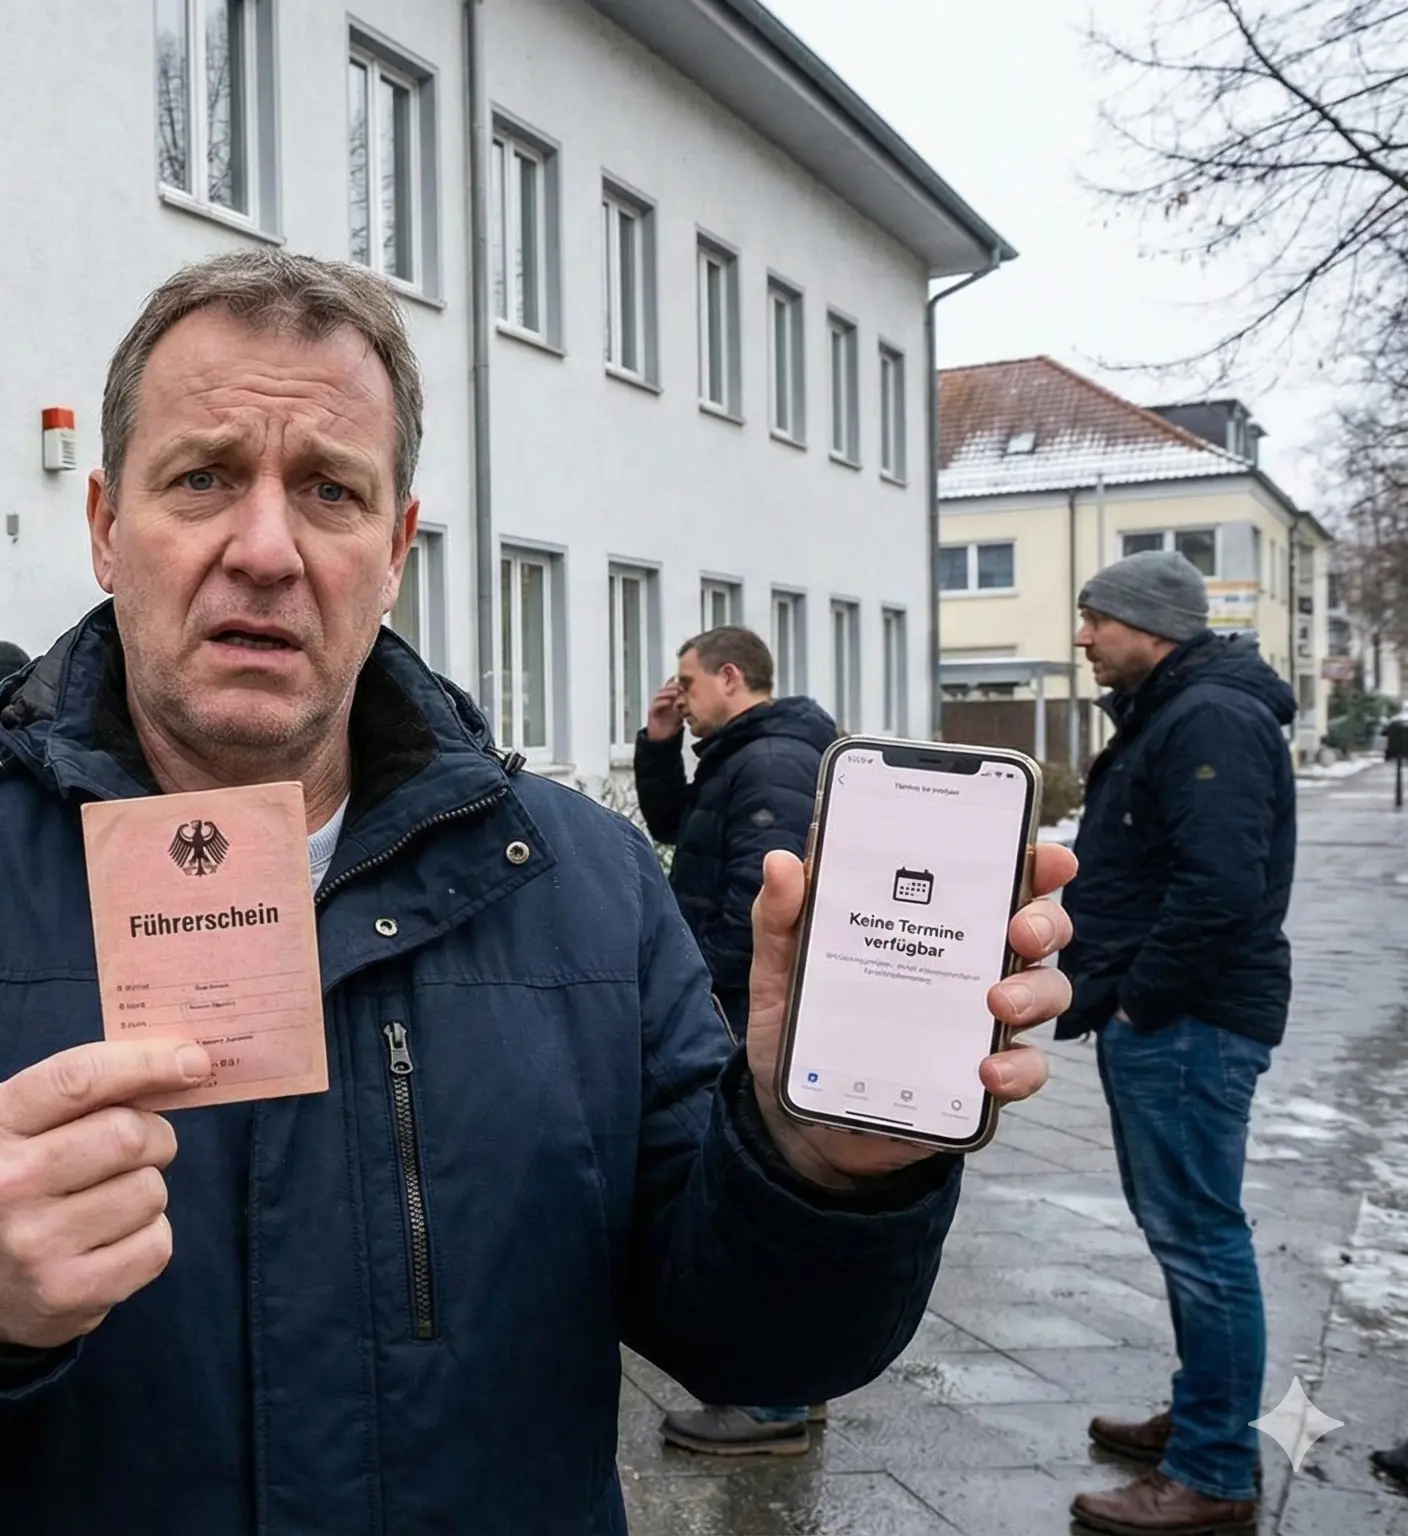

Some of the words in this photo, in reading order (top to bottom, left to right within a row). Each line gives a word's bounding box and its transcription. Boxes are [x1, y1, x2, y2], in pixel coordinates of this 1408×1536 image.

[129, 902, 279, 938] Führerschein
[849, 911, 895, 931] Keine
[898, 919, 965, 942] Termine
[864, 935, 946, 959] verfügbar
